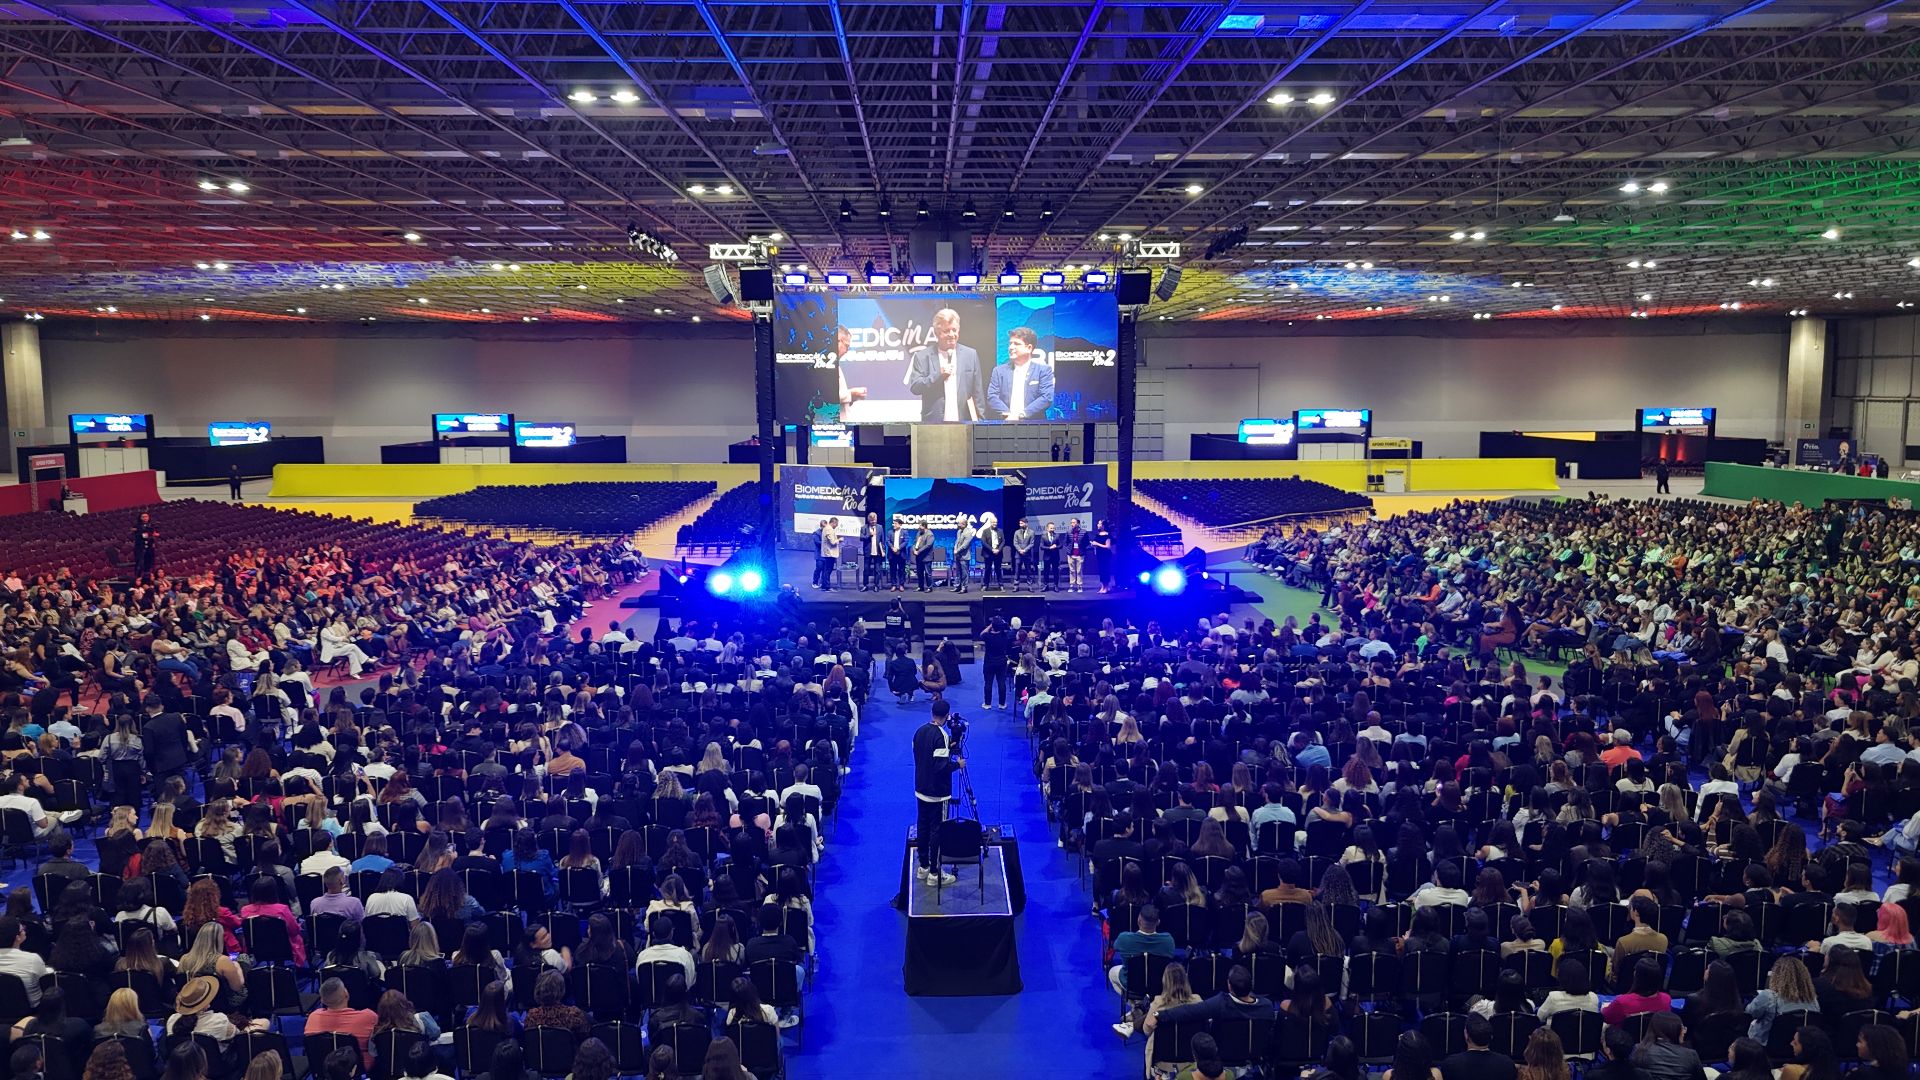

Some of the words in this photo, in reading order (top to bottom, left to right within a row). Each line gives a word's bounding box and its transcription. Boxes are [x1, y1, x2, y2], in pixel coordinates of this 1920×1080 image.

[826, 352, 837, 368] 2
[1104, 349, 1116, 366] 2
[1026, 483, 1080, 496] OMEDICinA
[1079, 482, 1093, 508] 2
